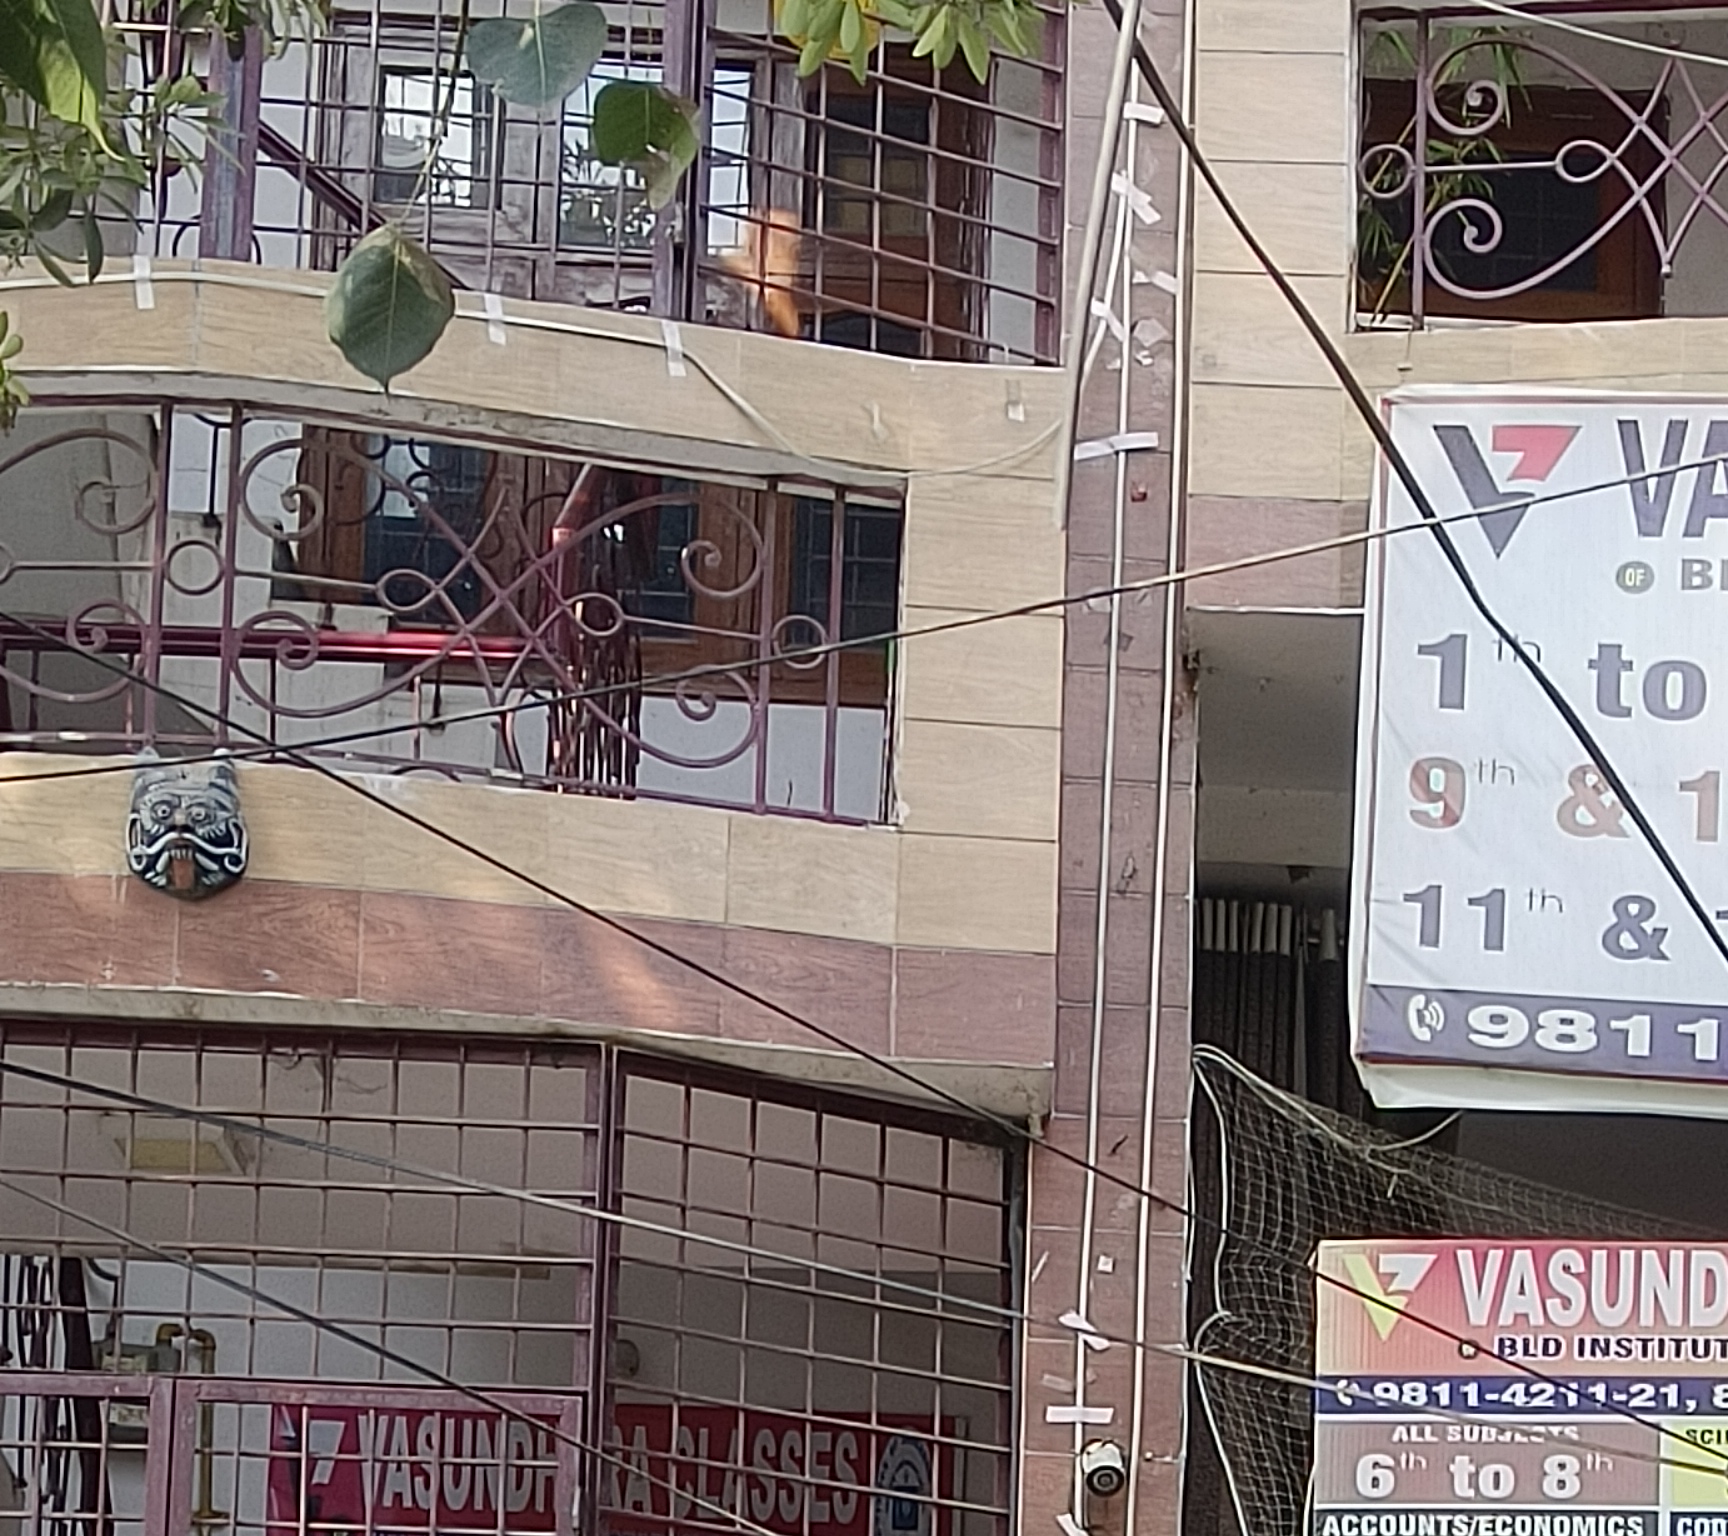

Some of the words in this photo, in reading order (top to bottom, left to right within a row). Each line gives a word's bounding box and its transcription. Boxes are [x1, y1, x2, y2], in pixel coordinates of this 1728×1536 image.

[1588, 643, 1708, 721] to
[1556, 764, 1631, 839] &
[1600, 895, 1673, 962] &
[1494, 1336, 1564, 1361] BLD
[1391, 1424, 1439, 1443] ALL
[1448, 1454, 1516, 1500] to
